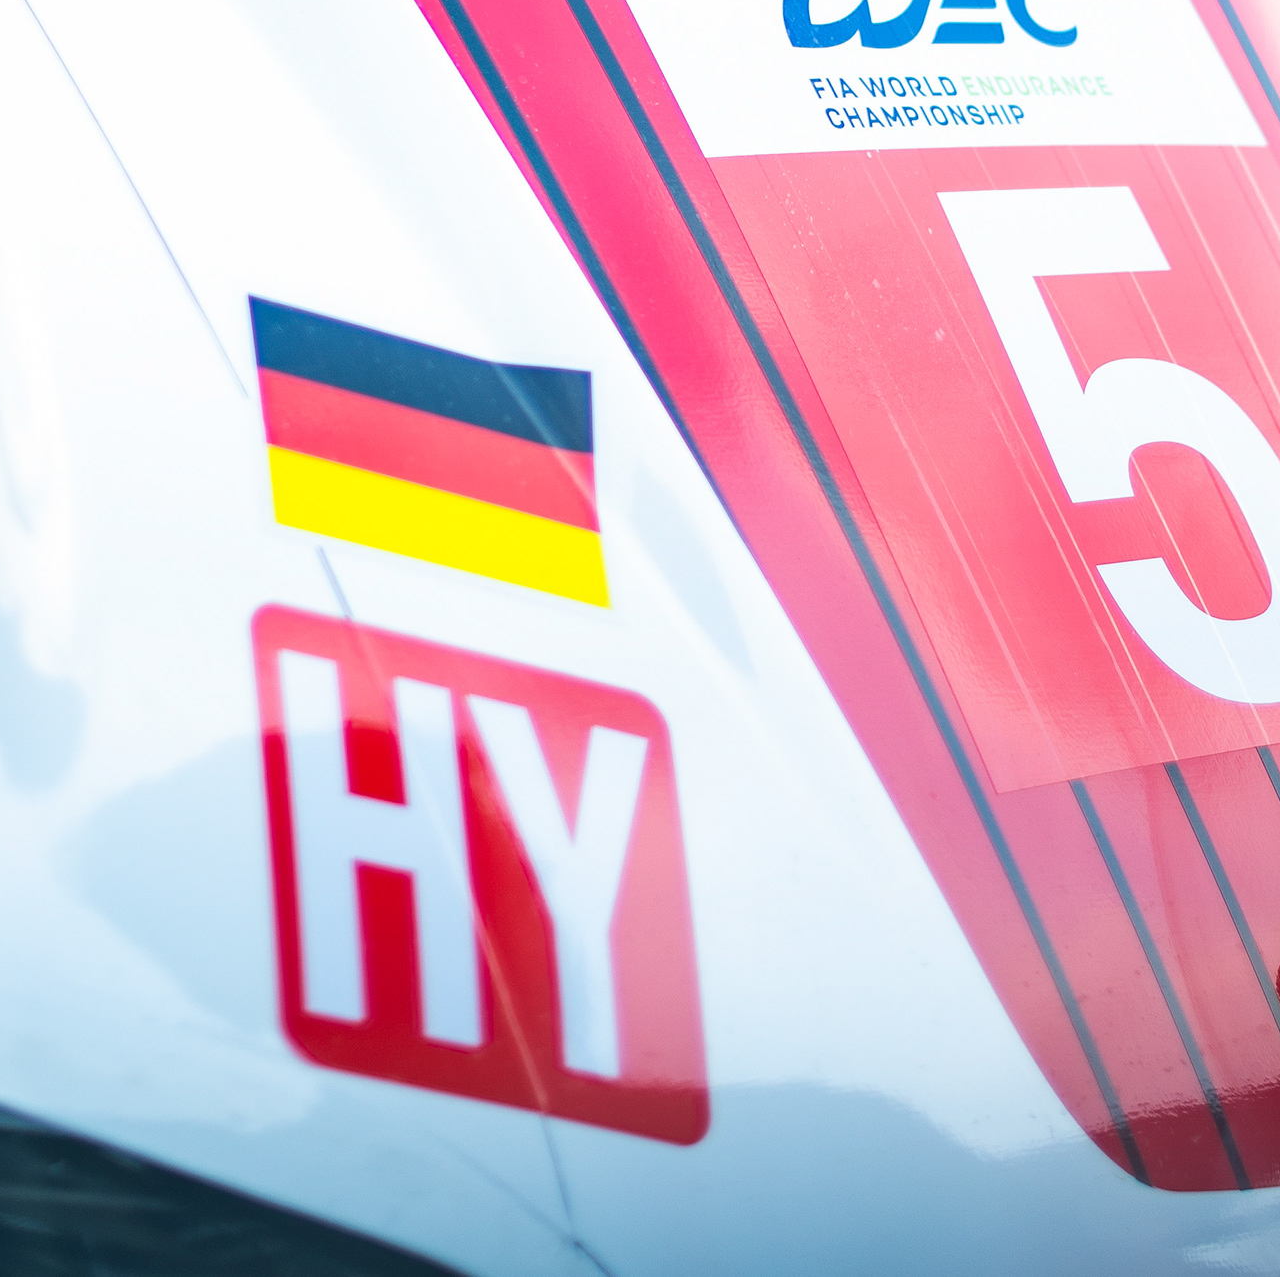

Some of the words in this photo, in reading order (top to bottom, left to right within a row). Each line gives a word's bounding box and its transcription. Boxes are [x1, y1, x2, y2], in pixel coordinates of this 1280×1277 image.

[810, 77, 858, 99] FIA
[858, 76, 958, 98] WORLD
[962, 75, 1114, 96] ENDURANCE
[825, 104, 1025, 129] CHAMPIONSHIP
[277, 647, 650, 1079] HY
